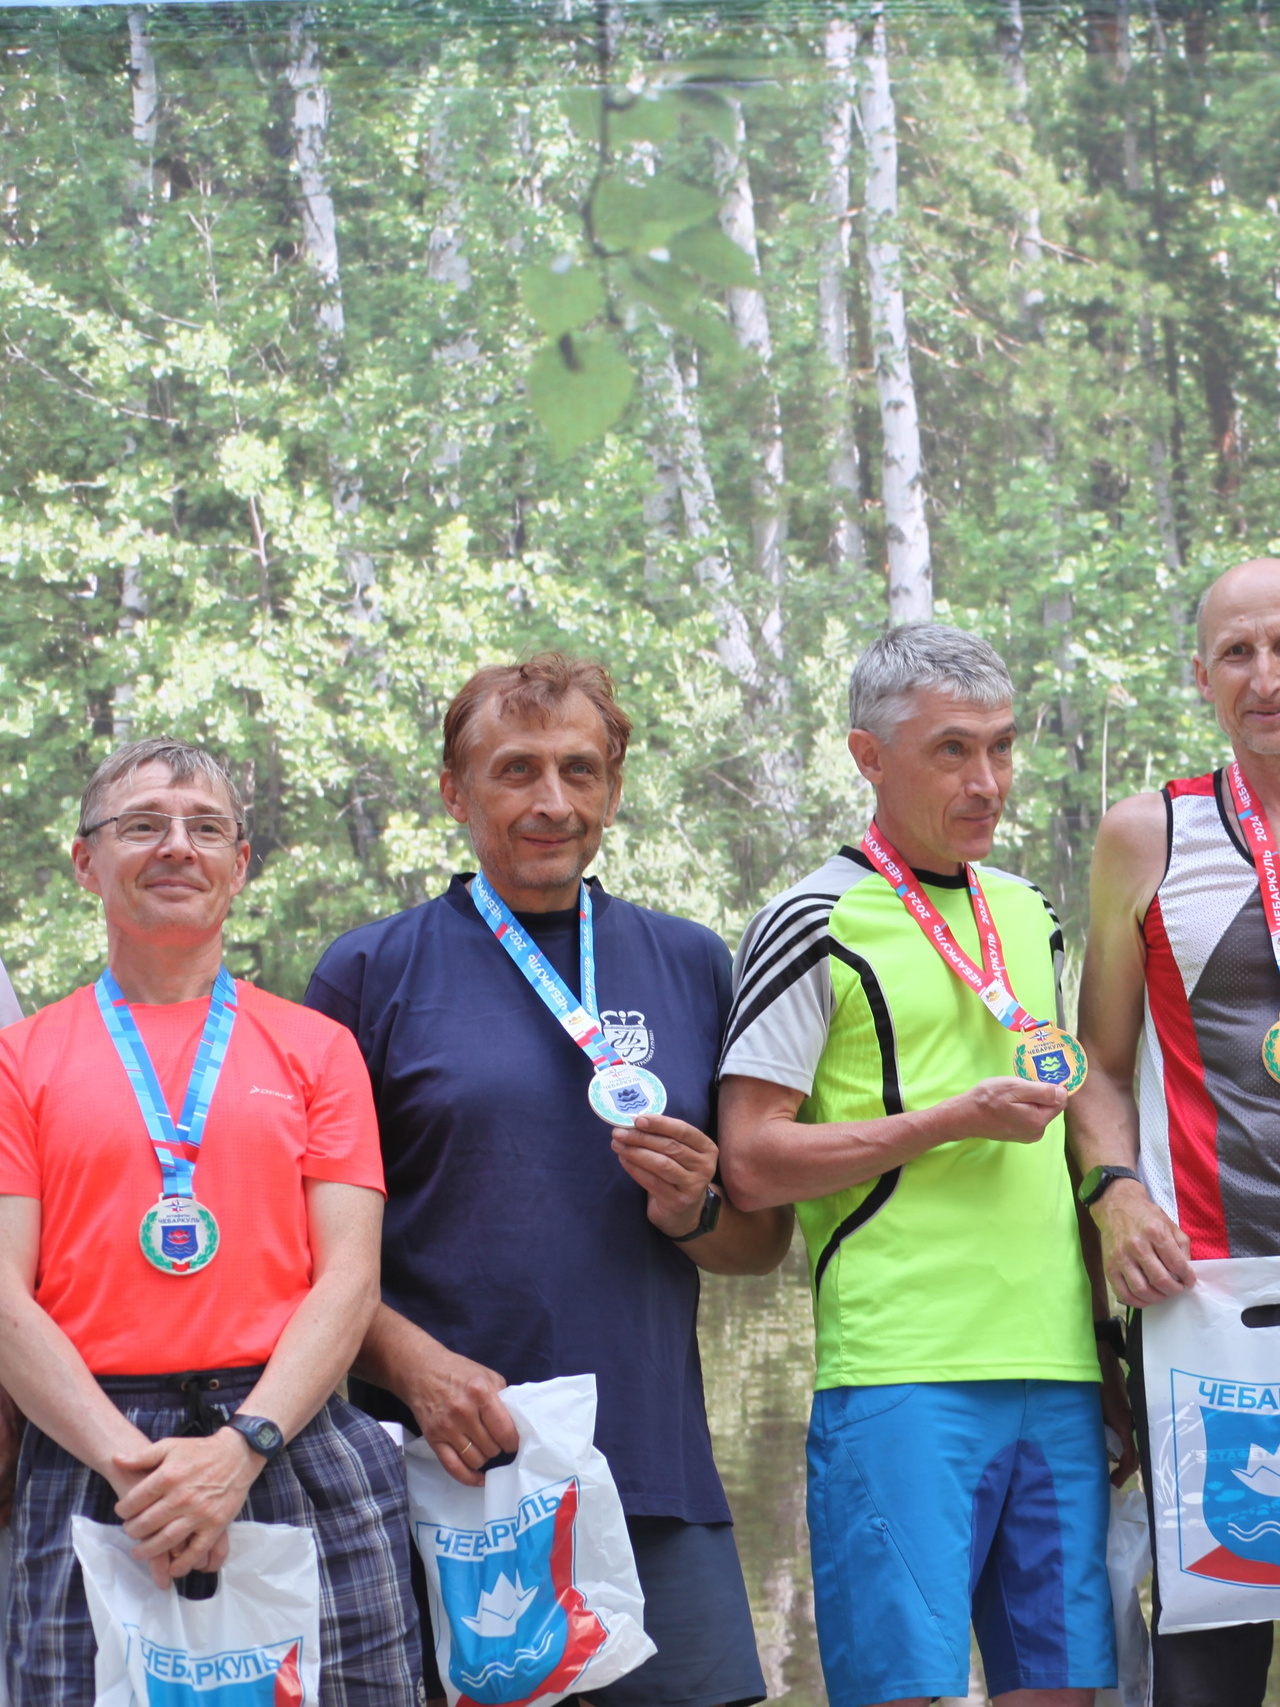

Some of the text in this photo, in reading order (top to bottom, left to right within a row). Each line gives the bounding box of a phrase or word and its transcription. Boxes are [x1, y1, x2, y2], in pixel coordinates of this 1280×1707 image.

[1250, 815, 1268, 842] 2024
[907, 891, 932, 919] 2024
[976, 897, 990, 925] 2024
[505, 925, 527, 951] 2024
[933, 925, 983, 988] ЧЕБАРКУЛЬ
[527, 953, 568, 1011] ЧЕБАРКУЛЬ
